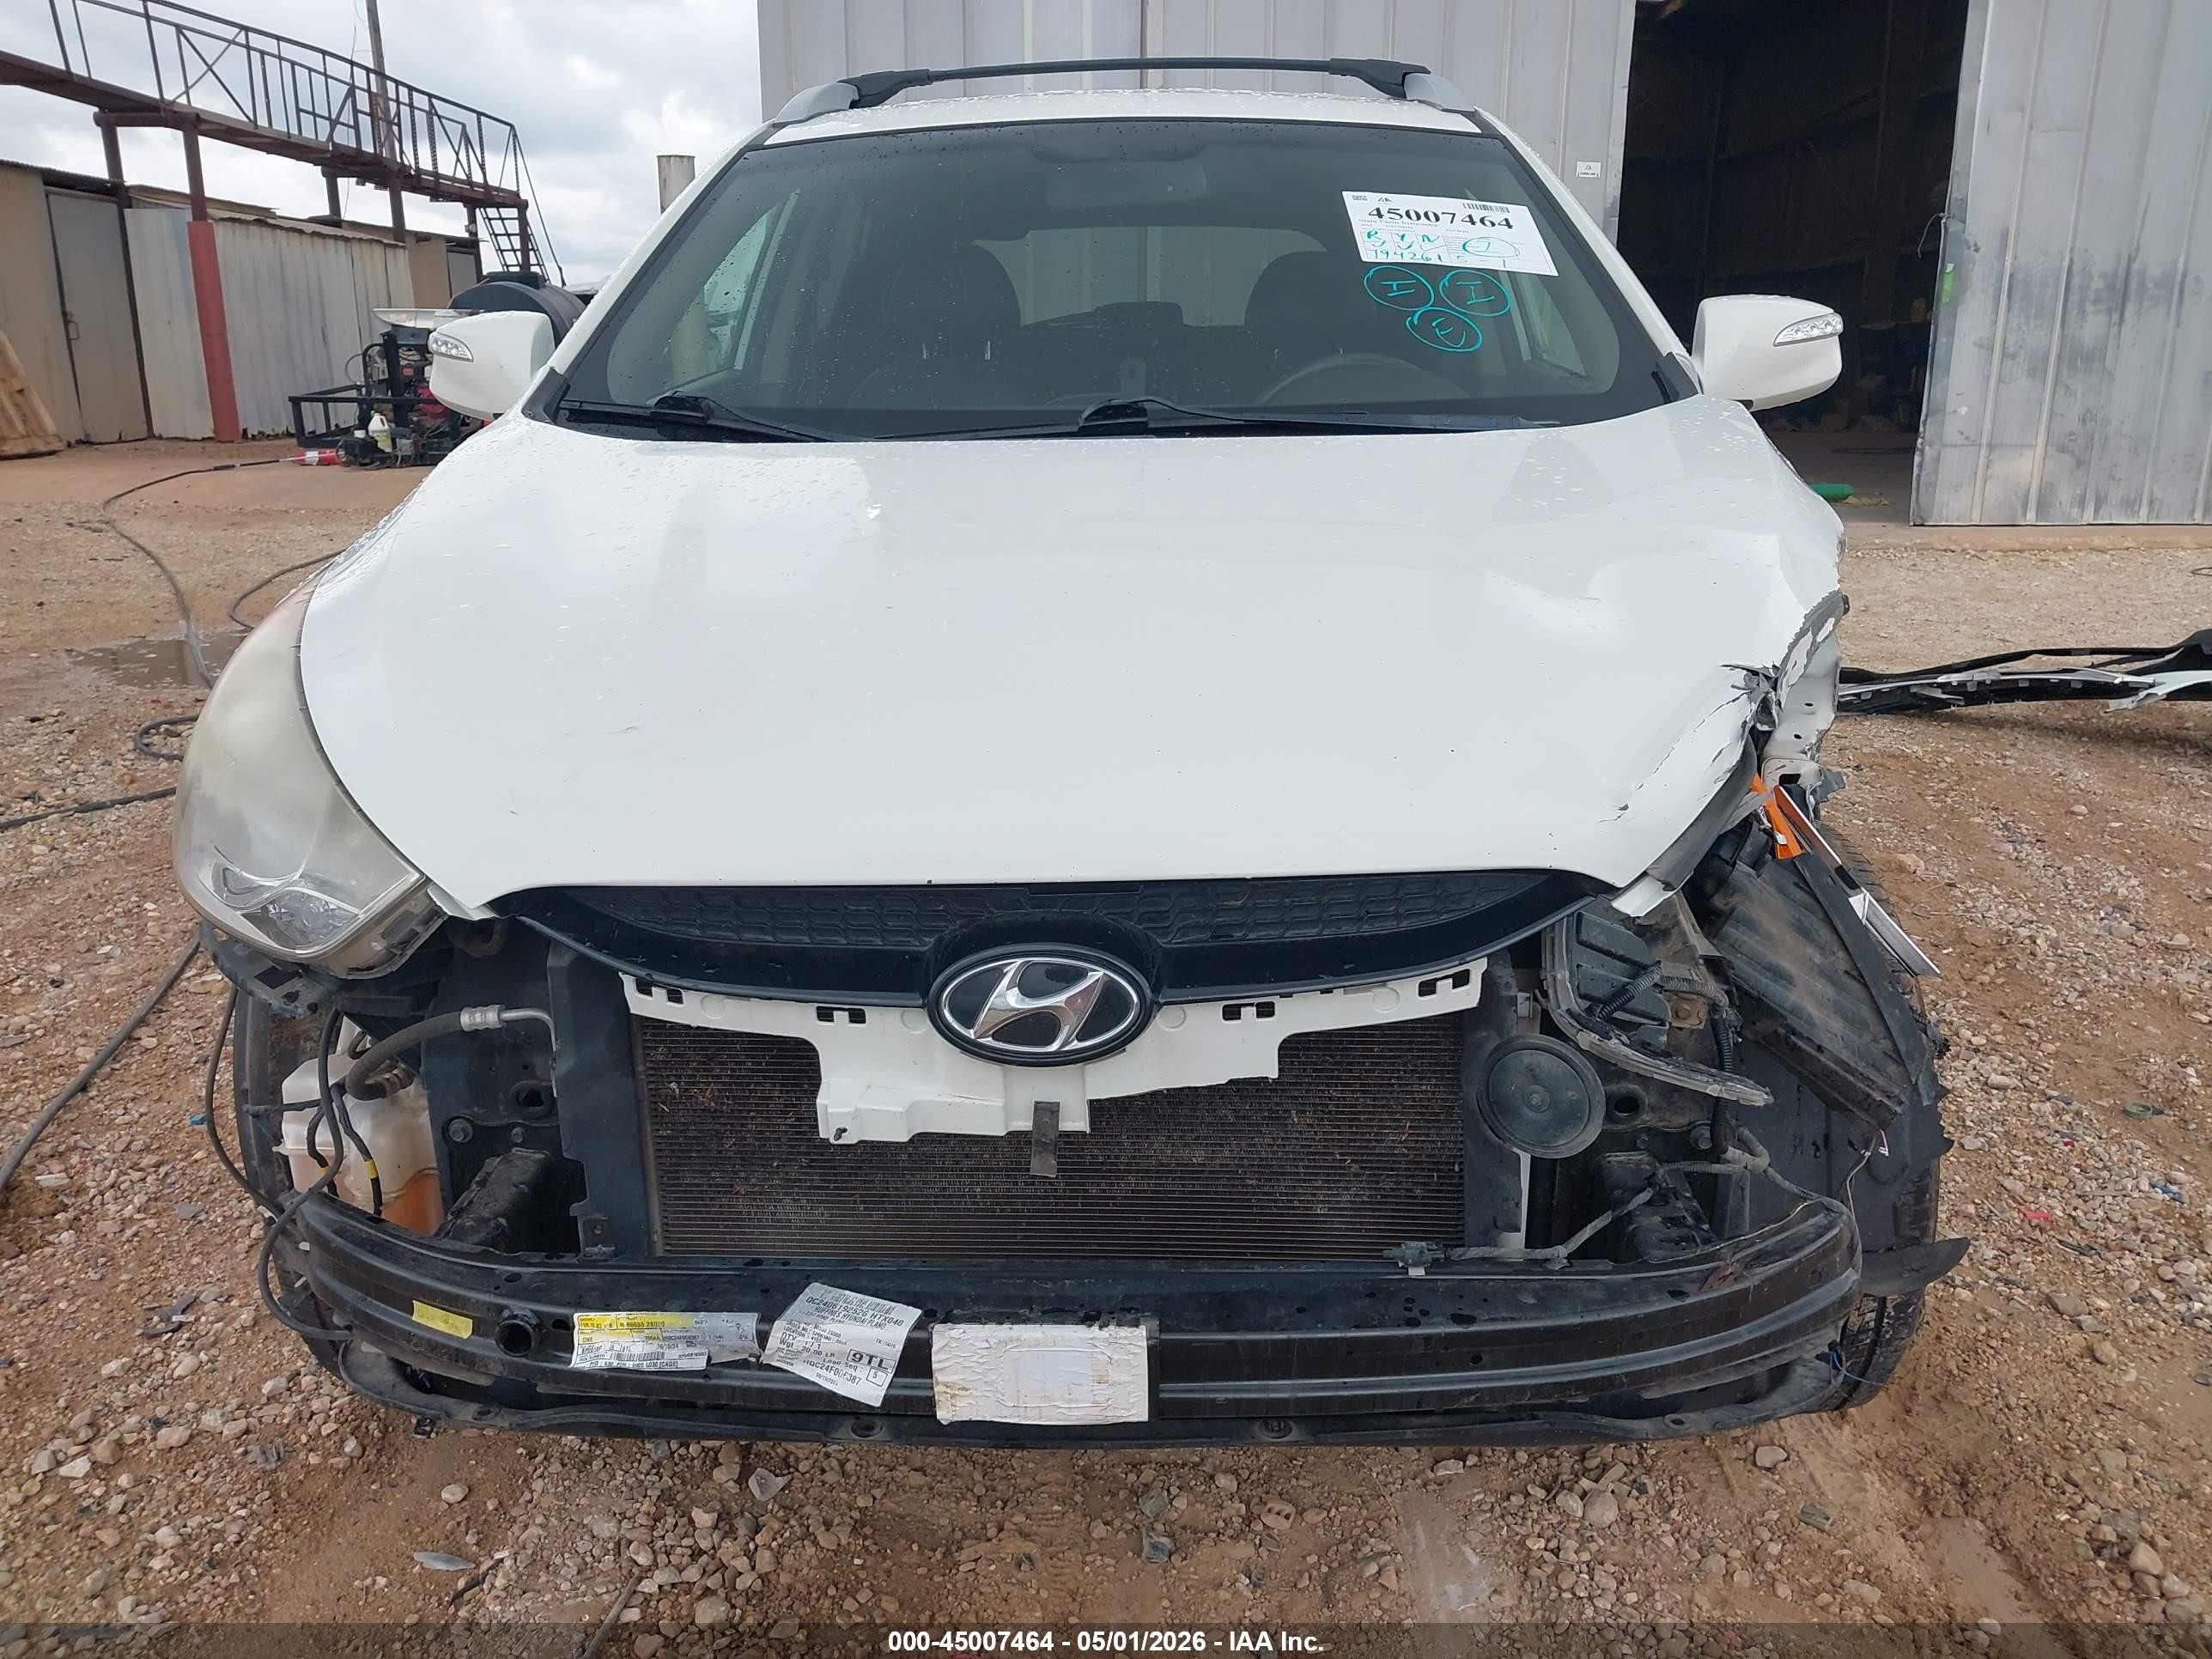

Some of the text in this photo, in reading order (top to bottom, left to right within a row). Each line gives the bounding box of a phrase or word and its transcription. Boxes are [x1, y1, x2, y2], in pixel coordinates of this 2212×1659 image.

[1368, 206, 1514, 229] 45007464
[842, 1312, 866, 1325] HYUNDAI
[851, 1352, 889, 1370] 9TL
